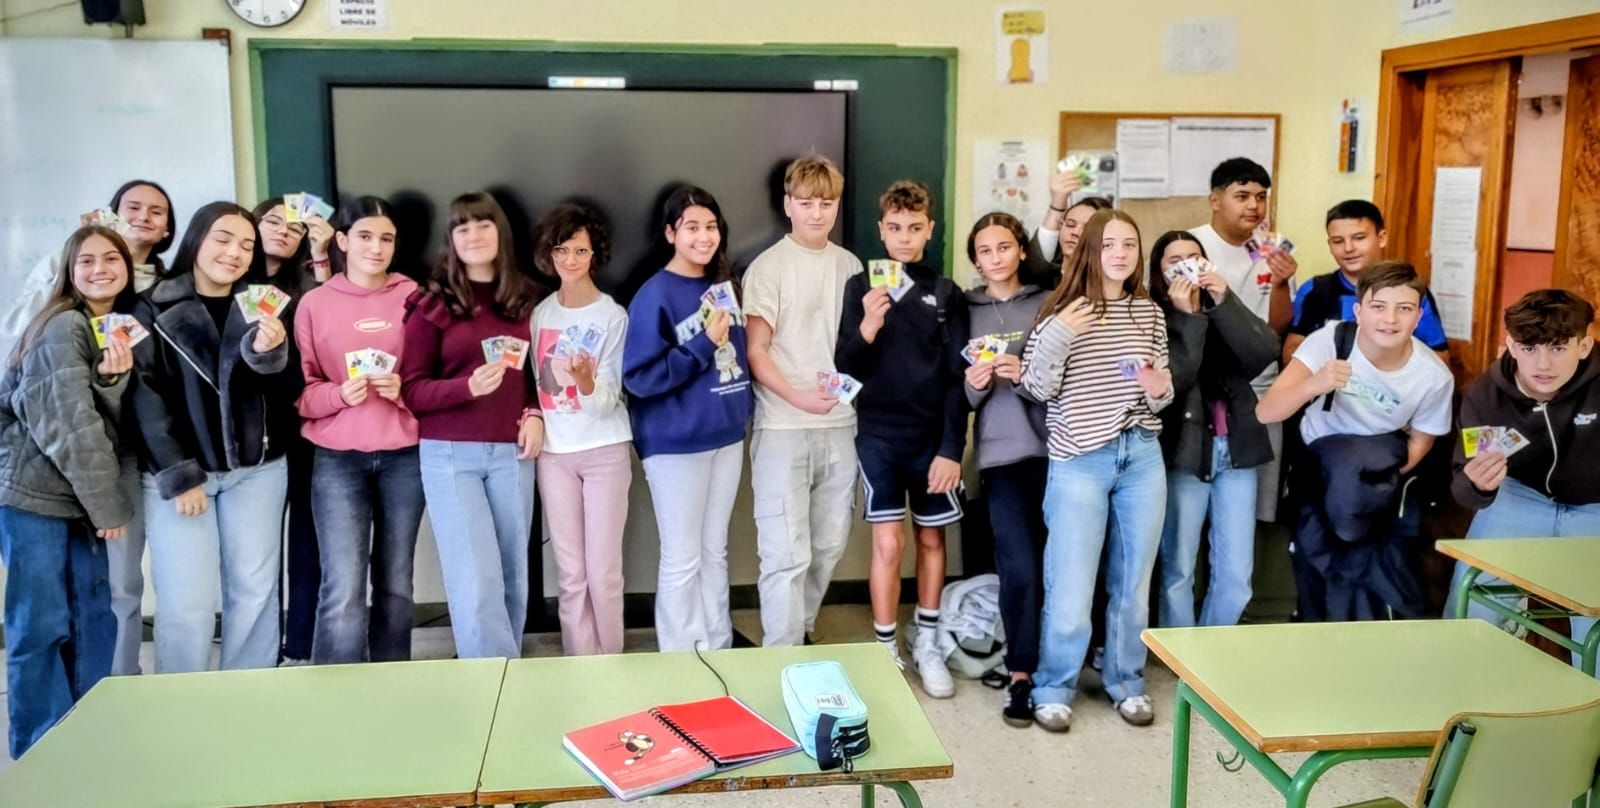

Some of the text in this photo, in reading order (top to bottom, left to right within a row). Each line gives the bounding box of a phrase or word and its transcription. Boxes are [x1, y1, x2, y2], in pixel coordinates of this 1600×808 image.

[245, 9, 252, 18] 7
[280, 10, 289, 19] 5
[263, 15, 271, 23] 6
